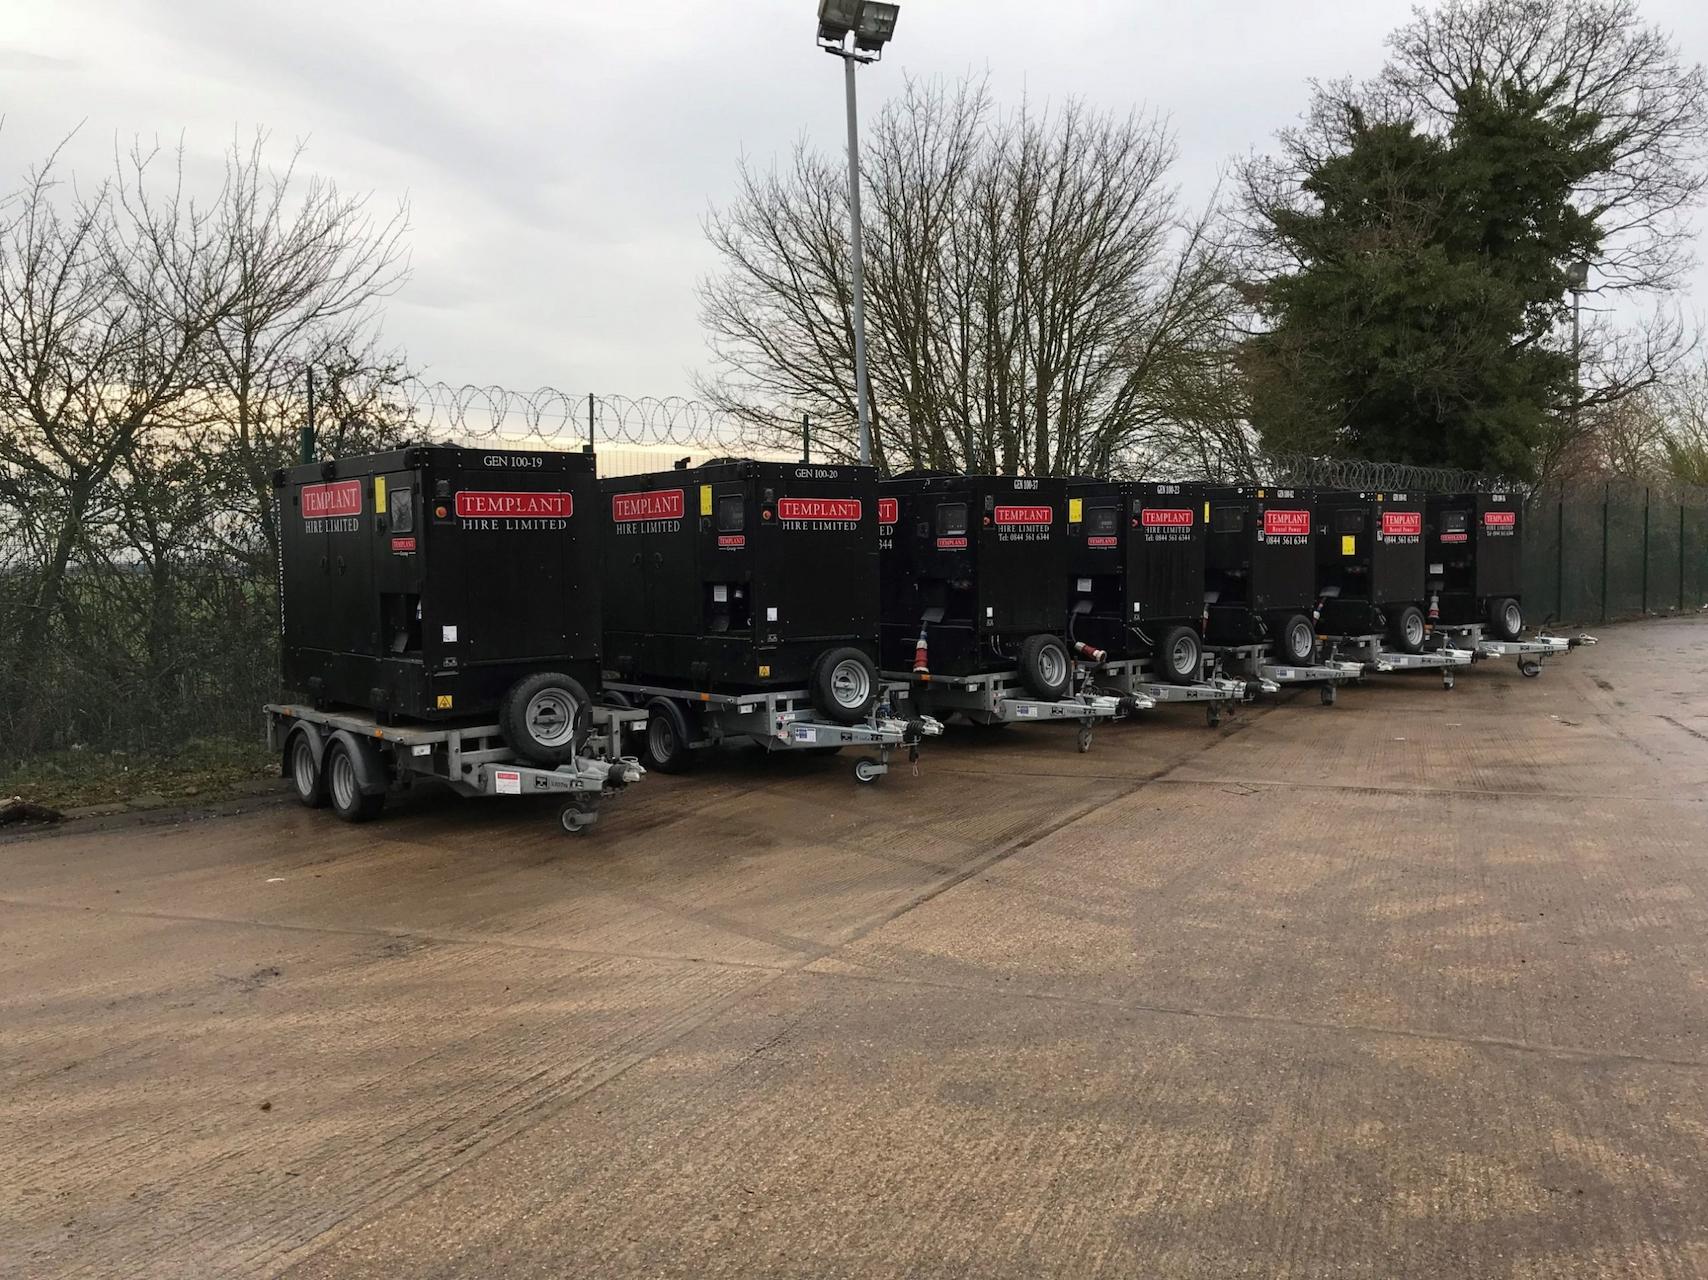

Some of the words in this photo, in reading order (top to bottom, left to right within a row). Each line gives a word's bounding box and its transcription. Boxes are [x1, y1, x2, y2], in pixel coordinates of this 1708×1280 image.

[483, 455, 508, 467] GEN
[511, 456, 543, 468] 100-19
[795, 468, 813, 478] GEN
[814, 469, 838, 479] 100-20
[304, 488, 358, 511] TEMPLANT
[462, 496, 565, 512] TEMPLANT
[616, 495, 680, 516] TEMPLANT
[783, 502, 857, 516] TEMPLANT
[998, 509, 1050, 520] TEMPLANT
[1145, 512, 1191, 523] TEMPLANT
[1267, 513, 1308, 524] TEMPLANT
[305, 520, 323, 534] HIRE
[325, 518, 359, 533] LIMITED
[462, 519, 499, 530] HIRE
[506, 519, 567, 530] LIMITED
[616, 523, 638, 535] HIRE
[640, 520, 681, 534] LIMITED
[782, 521, 808, 531] HIRE
[812, 521, 857, 531] LIMITED
[998, 524, 1016, 533] HIRE
[1018, 524, 1050, 533] LIMITED
[1162, 526, 1191, 534] LIMITED
[719, 537, 743, 545] TEMPLANT
[1009, 533, 1023, 541] 0844
[1025, 533, 1035, 541] 561
[1036, 533, 1050, 541] 6344
[1293, 536, 1308, 545] 6344
[878, 538, 893, 550] 344
